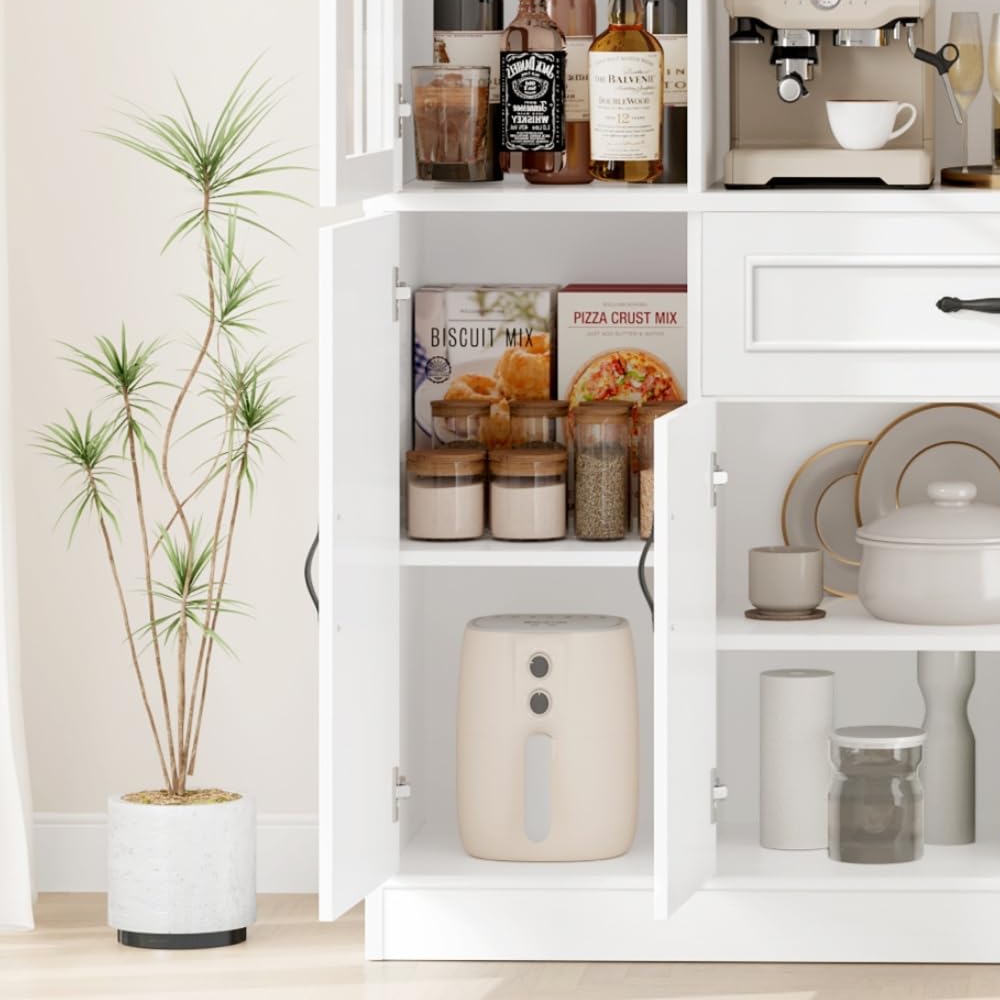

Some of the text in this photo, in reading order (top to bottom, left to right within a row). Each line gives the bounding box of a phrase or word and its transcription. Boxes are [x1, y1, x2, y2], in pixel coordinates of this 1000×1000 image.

[617, 112, 630, 124] 12
[573, 311, 678, 324] PIZZA CRUST MIX
[430, 327, 534, 347] BISCUIT MIX
